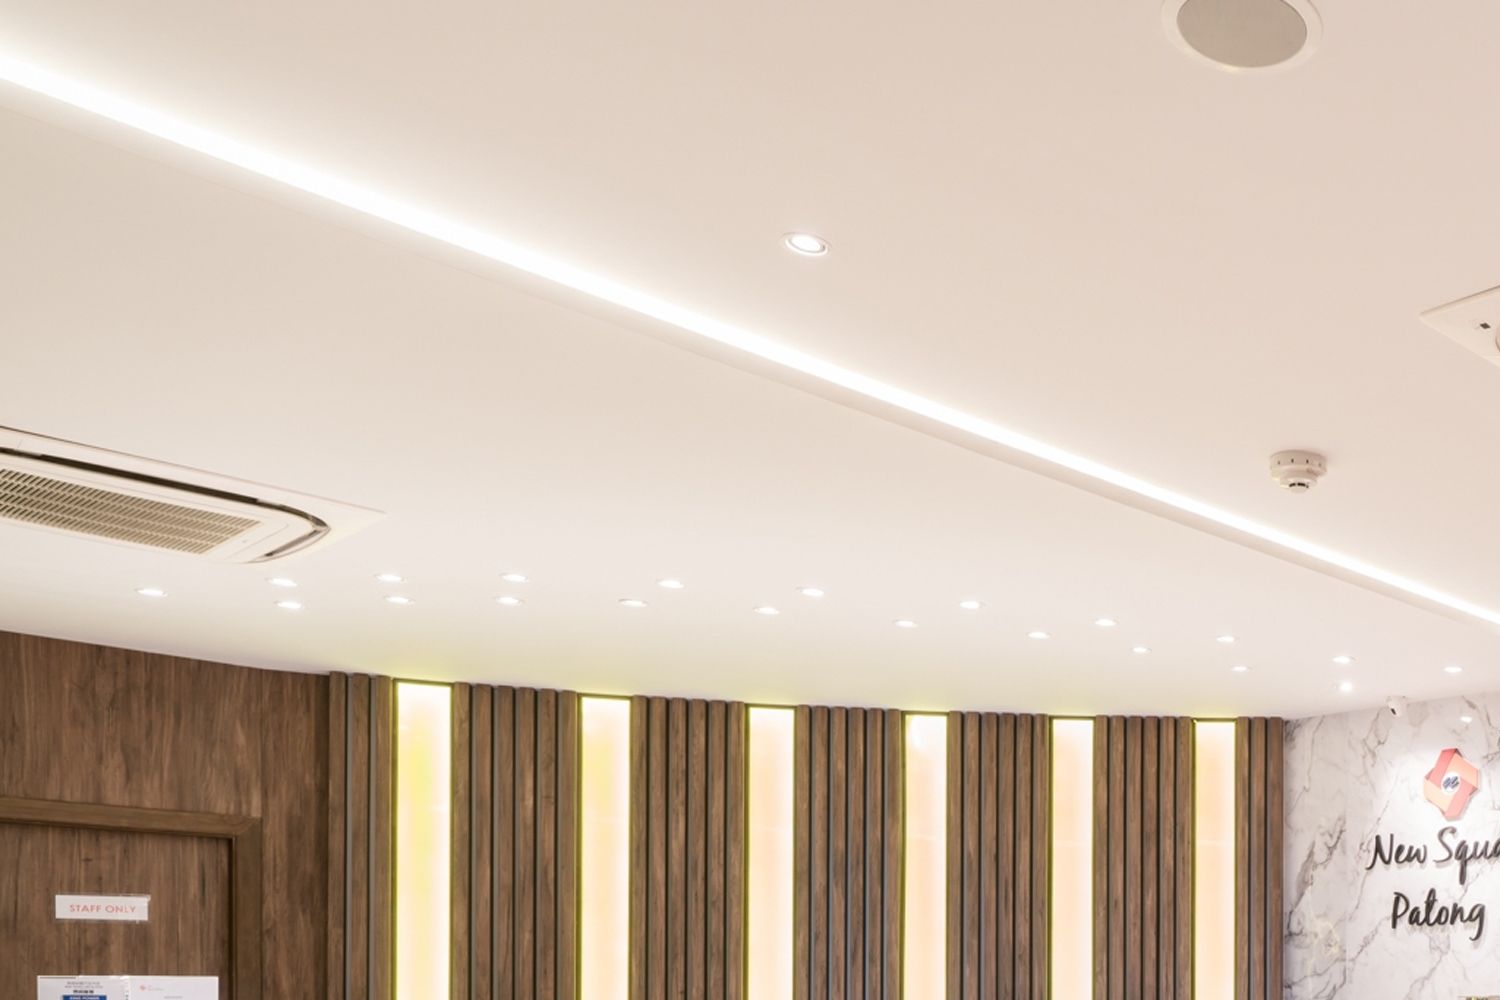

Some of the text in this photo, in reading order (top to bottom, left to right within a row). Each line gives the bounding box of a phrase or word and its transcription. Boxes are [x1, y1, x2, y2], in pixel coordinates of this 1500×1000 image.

[1365, 833, 1427, 870] New
[69, 903, 136, 913] STAFF ONLY
[1391, 887, 1486, 941] Patong
